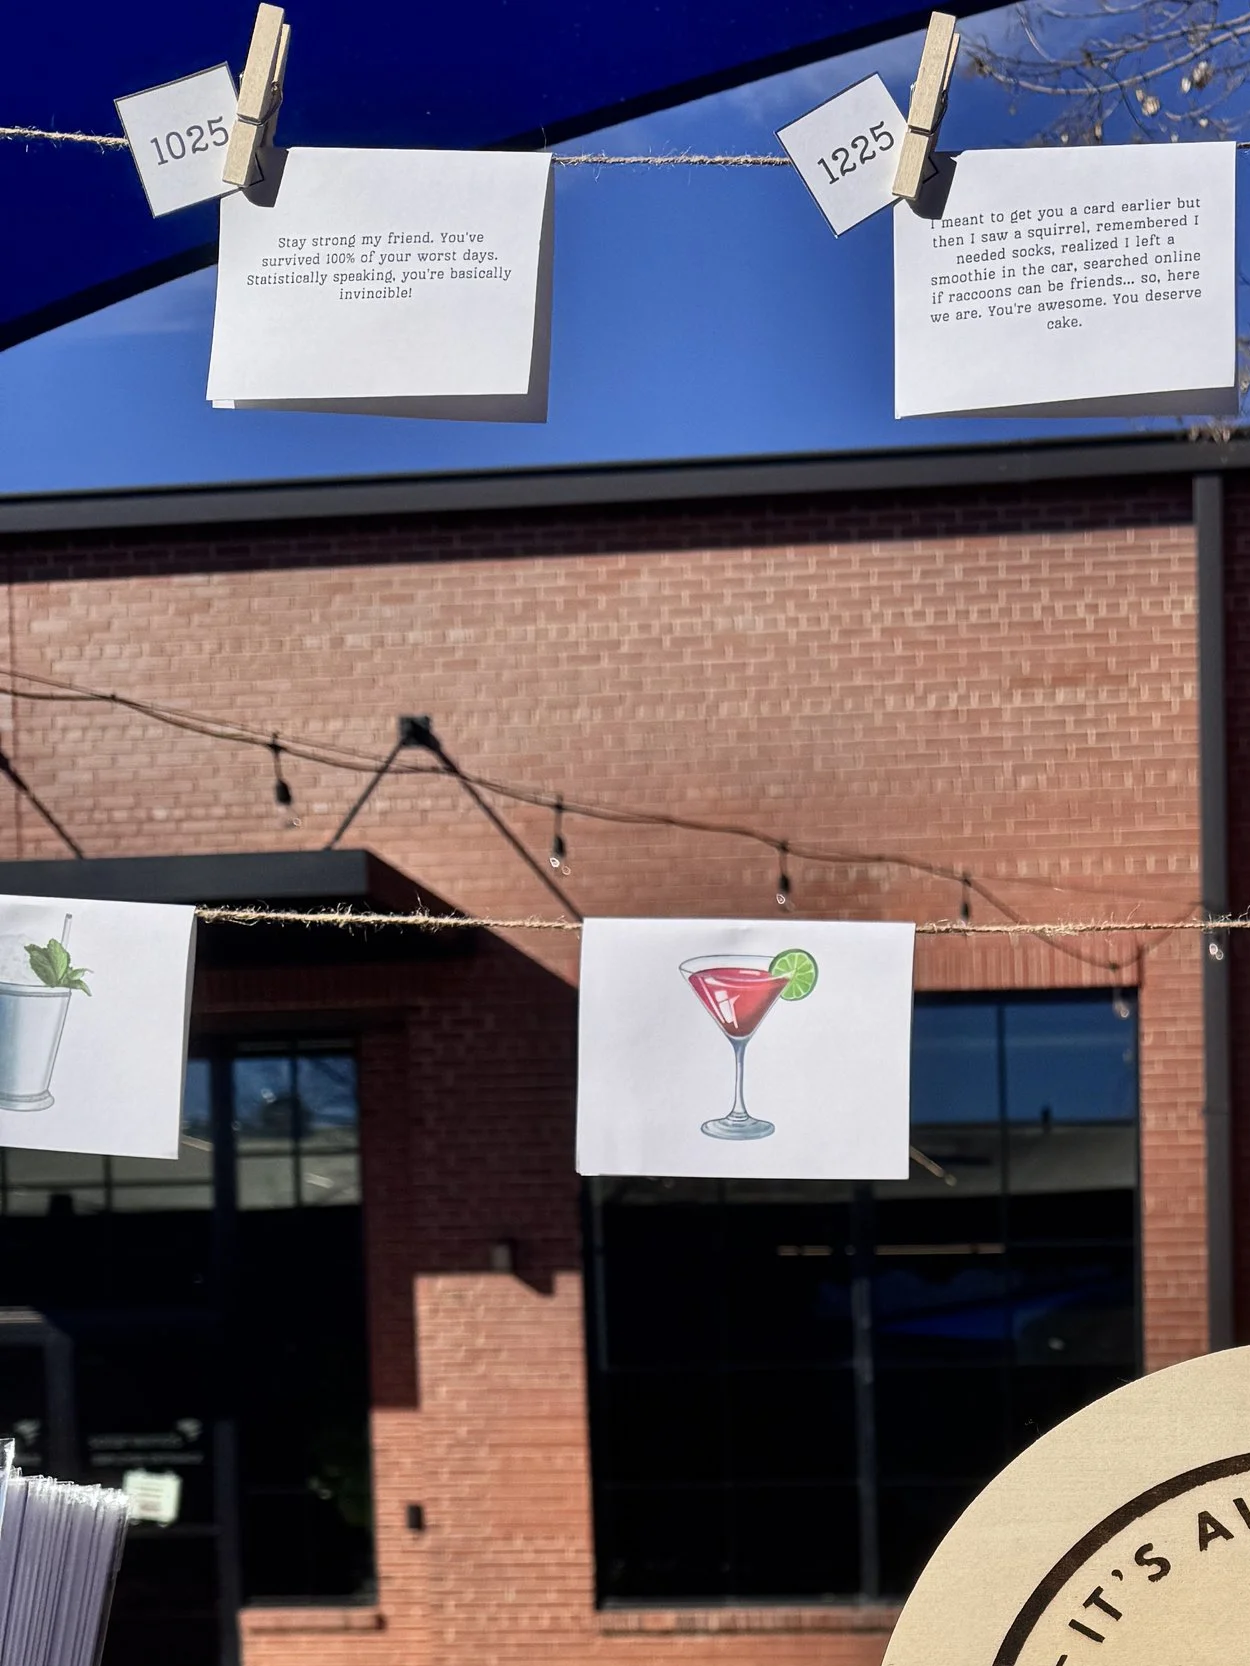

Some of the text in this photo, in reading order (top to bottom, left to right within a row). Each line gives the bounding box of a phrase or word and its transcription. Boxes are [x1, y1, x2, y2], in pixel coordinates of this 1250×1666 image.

[150, 115, 230, 166] 1025
[817, 120, 895, 185] 1225
[941, 213, 985, 229] meant
[990, 212, 1005, 224] to
[1010, 209, 1032, 224] get
[1037, 207, 1064, 222] you
[1069, 206, 1078, 216] a
[1083, 200, 1115, 215] card
[1121, 198, 1172, 213] earlier
[1176, 197, 1201, 209] but
[278, 231, 484, 251] Stay strong my friend. You've
[932, 214, 1199, 249] then I saw a squirrel, remembered I
[261, 248, 498, 268] survived 100% of your worst days.
[956, 233, 1175, 265] needed socks, realized I left a
[246, 266, 512, 286] Statistically speaking, you're basically
[930, 249, 1201, 286] smoothie in the car, searched online
[339, 286, 412, 300] invincible!
[932, 268, 1200, 305] if raccoons can be friends... so, here
[930, 288, 1202, 323] we are. You're awesome. You deserve
[1046, 315, 1083, 330] cake.
[1067, 1542, 1172, 1644] IT'S
